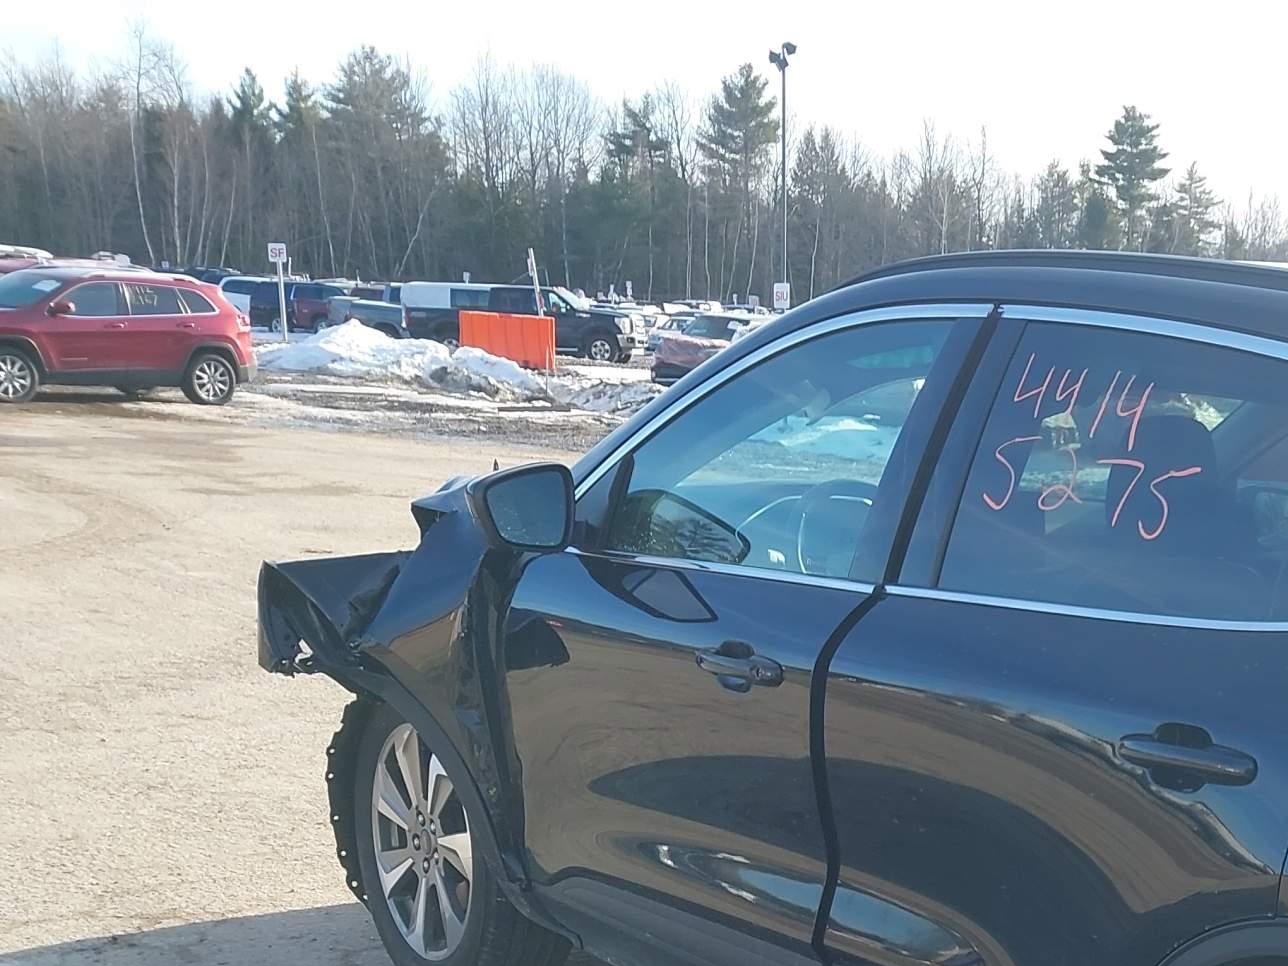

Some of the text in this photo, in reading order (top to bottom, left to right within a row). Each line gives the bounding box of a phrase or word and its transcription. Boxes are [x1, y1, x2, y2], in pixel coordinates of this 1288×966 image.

[270, 247, 285, 258] SF
[775, 290, 789, 302] SIU
[1013, 352, 1155, 452] 4414
[982, 435, 1203, 540] 5275
